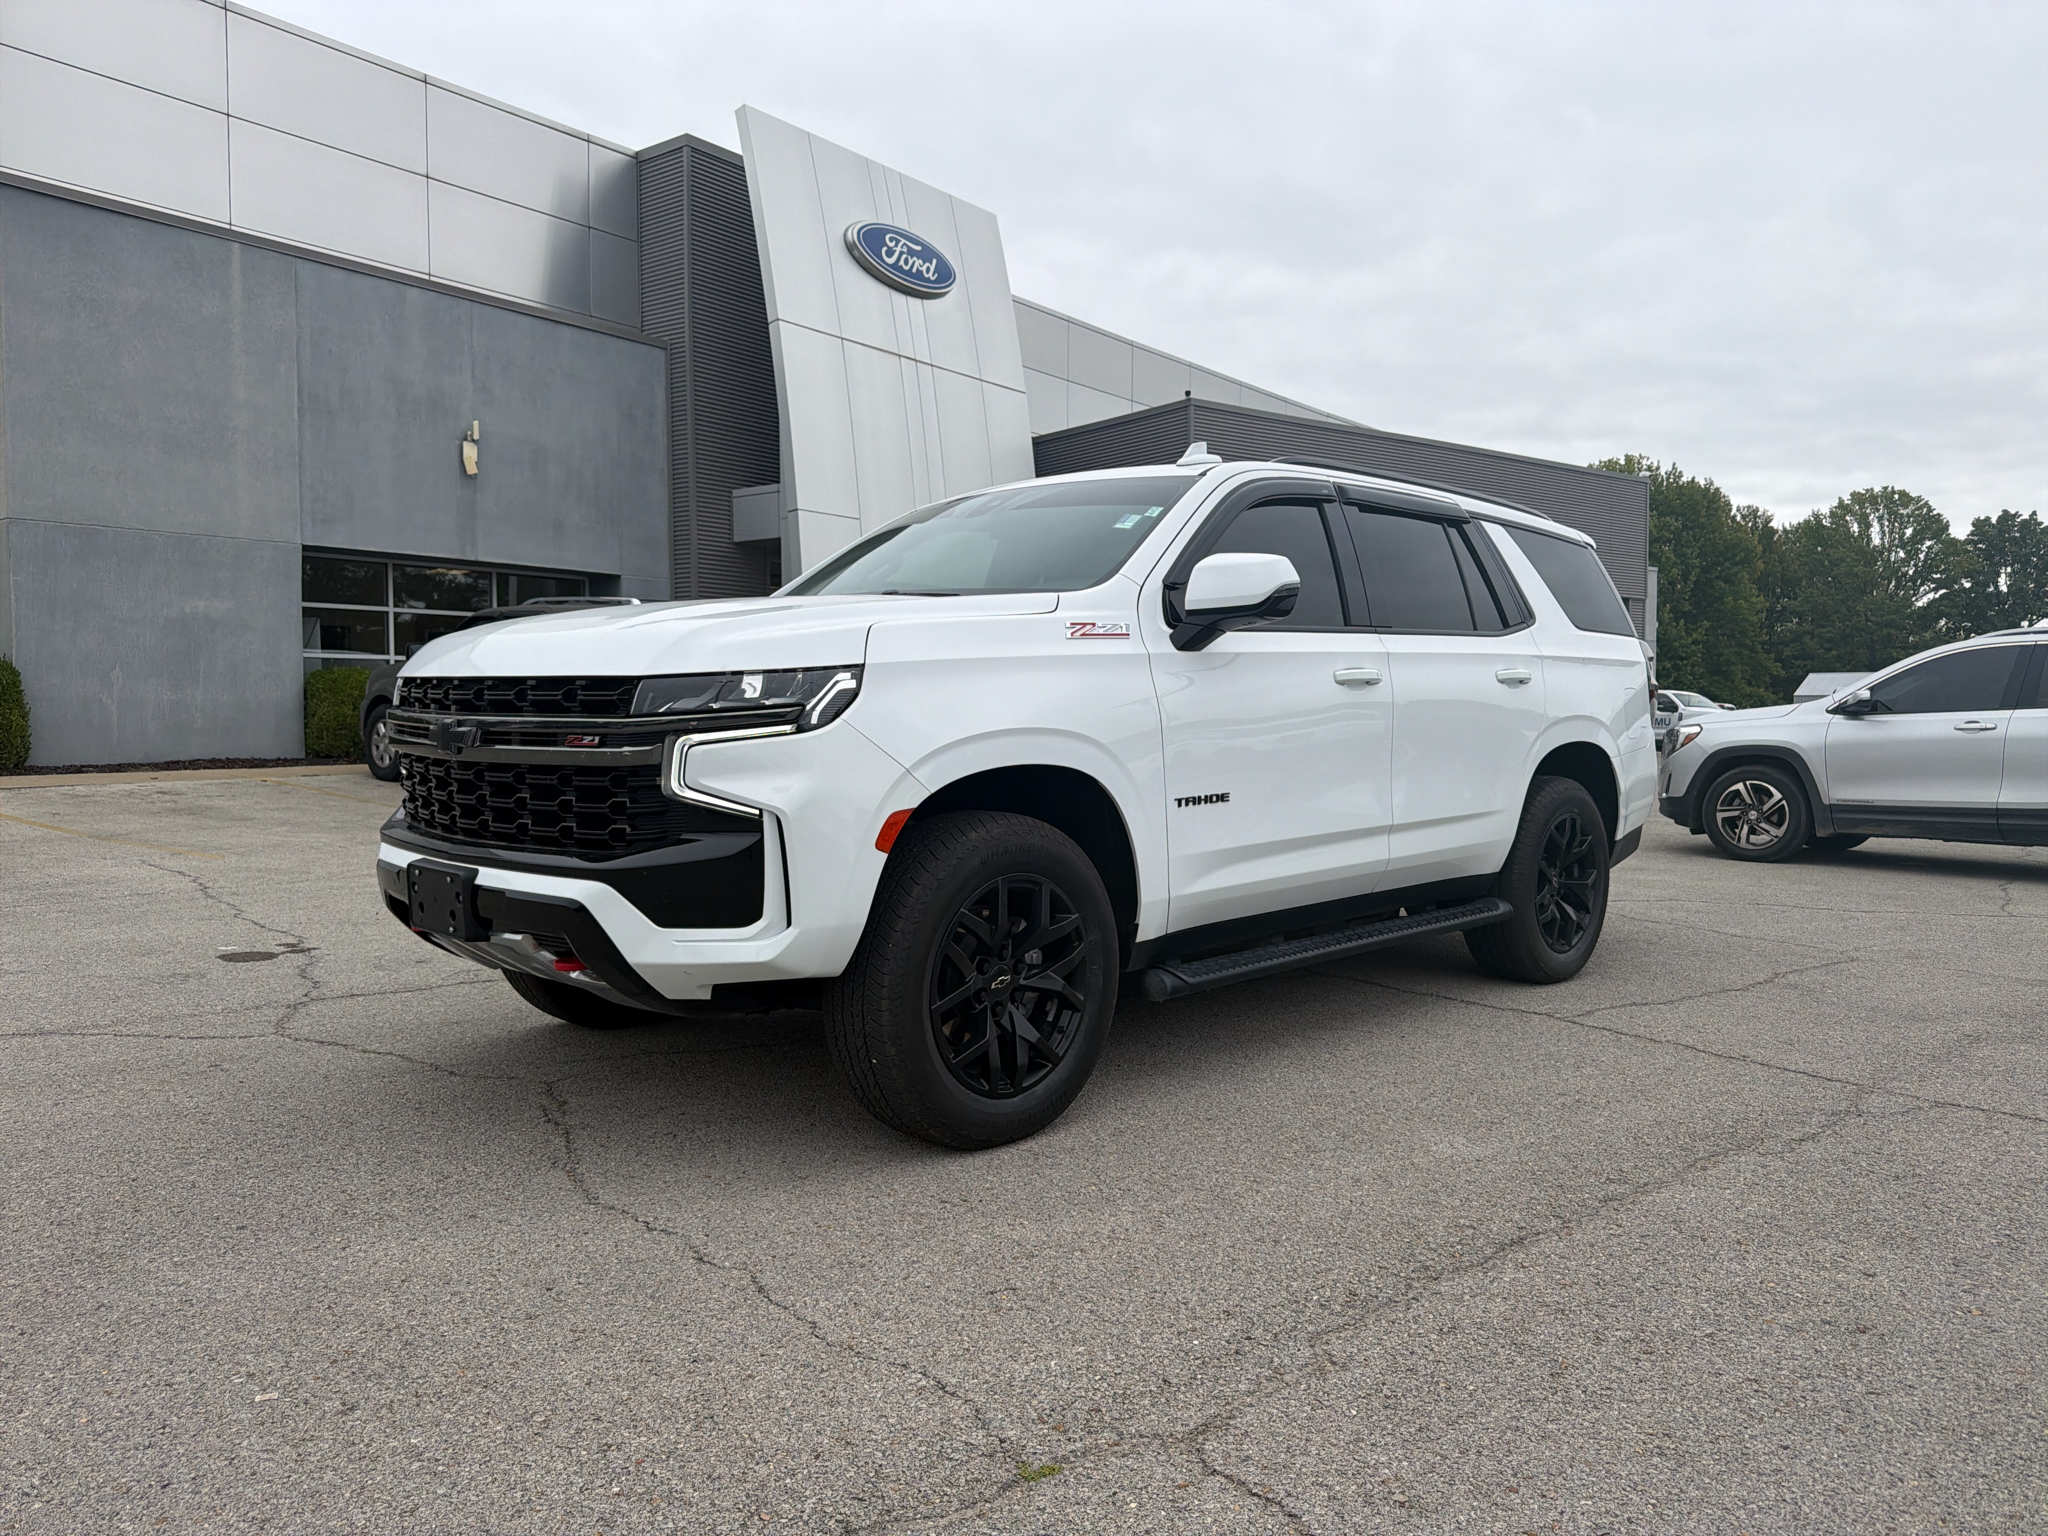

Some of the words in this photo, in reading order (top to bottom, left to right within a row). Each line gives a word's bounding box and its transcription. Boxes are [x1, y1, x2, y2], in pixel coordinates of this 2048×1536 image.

[881, 233, 938, 281] Ford
[1065, 622, 1130, 639] Z71
[565, 735, 601, 746] Z71
[1174, 792, 1230, 808] TAHOE
